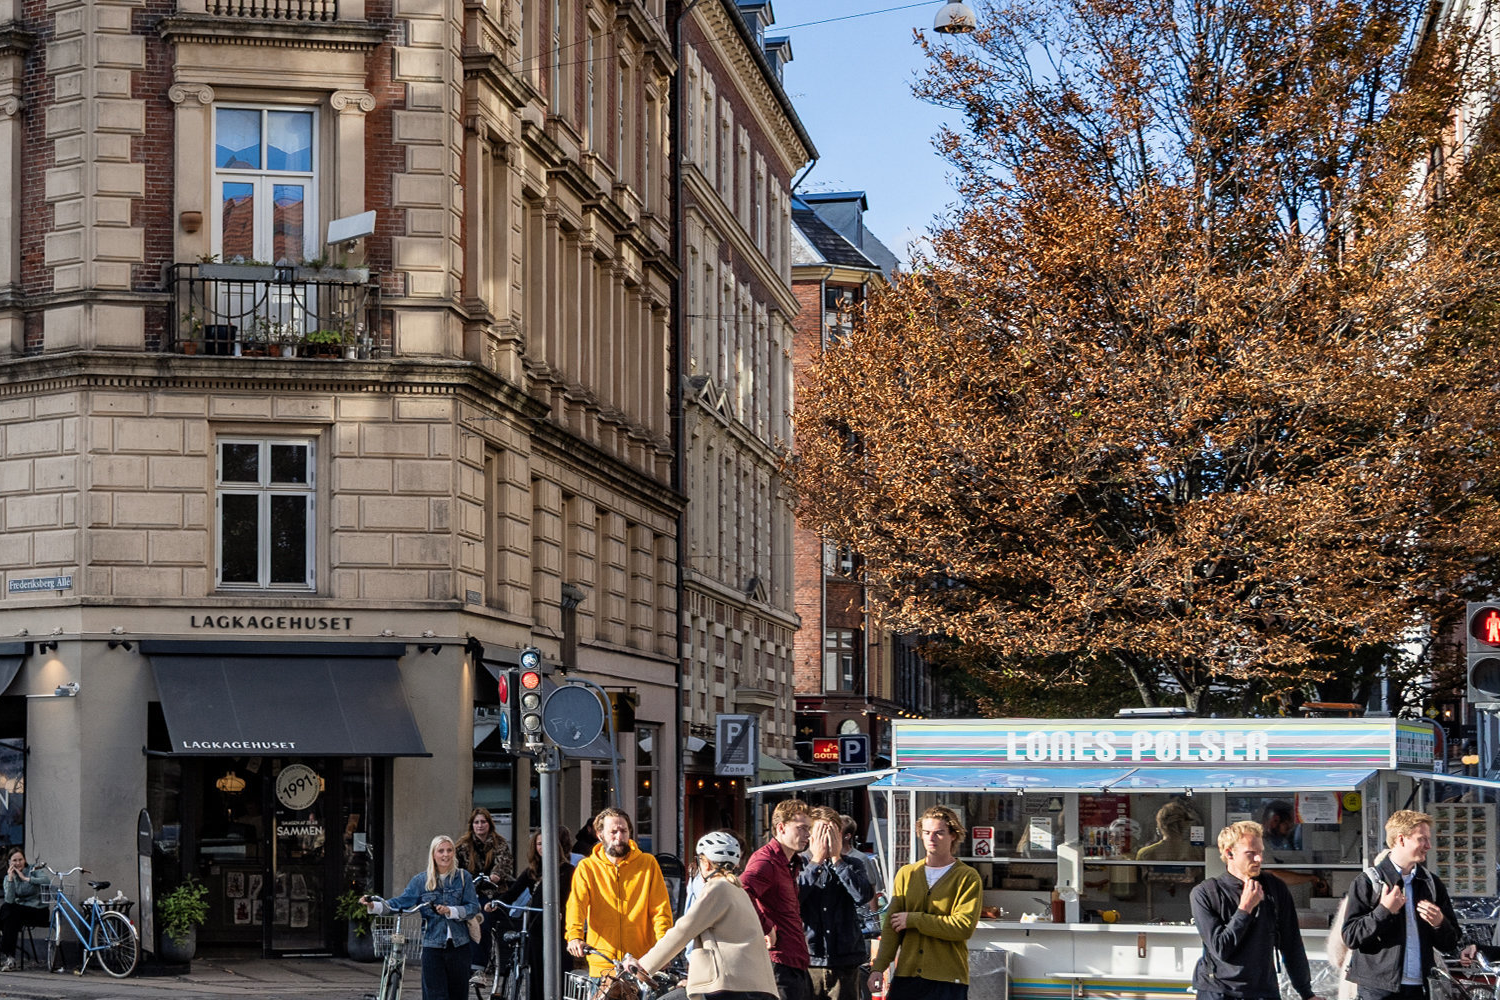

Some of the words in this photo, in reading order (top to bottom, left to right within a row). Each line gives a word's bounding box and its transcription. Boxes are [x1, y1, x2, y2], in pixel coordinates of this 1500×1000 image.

[9, 579, 55, 590] Frederiksberg
[56, 577, 71, 587] Allé
[190, 615, 353, 630] LAGKAGEHUSET
[726, 722, 743, 744] P
[182, 740, 296, 749] LAGKAGEHUSET
[844, 739, 861, 762] P
[1006, 730, 1117, 762] LONES
[1131, 730, 1269, 762] PØLSER
[724, 765, 745, 773] Zone
[282, 774, 313, 799] 1991
[276, 826, 323, 836] SAMMEN
